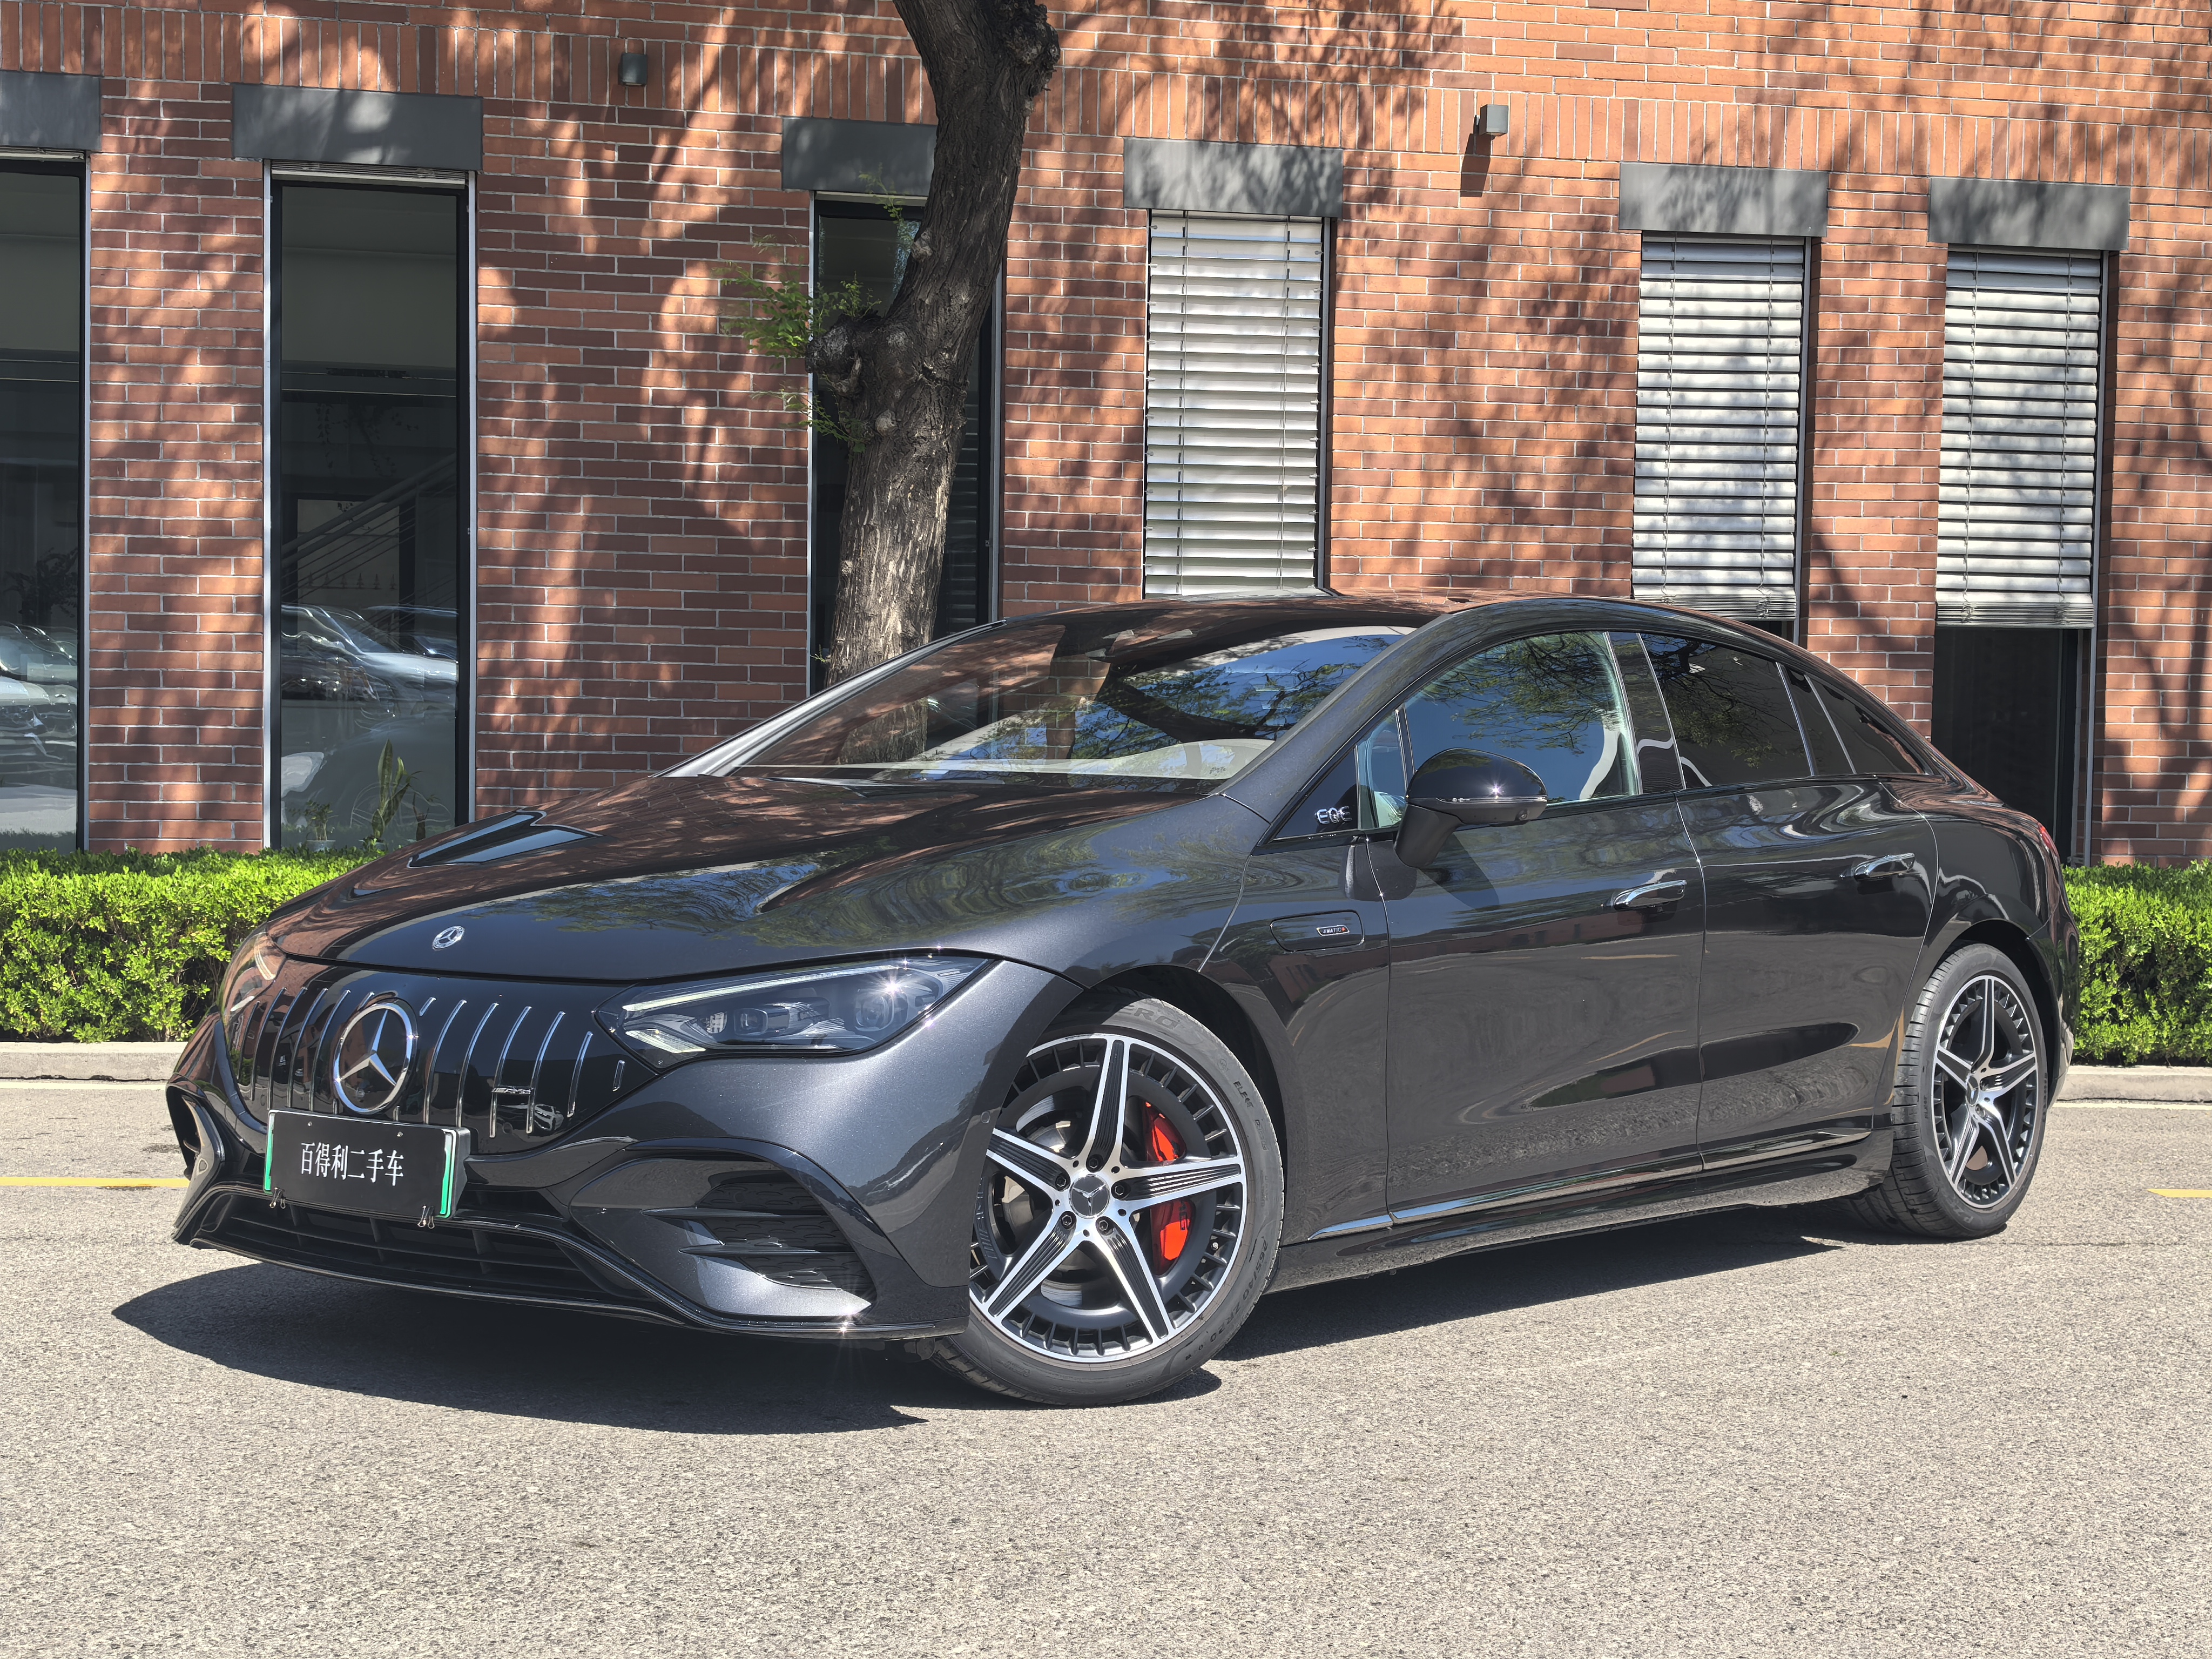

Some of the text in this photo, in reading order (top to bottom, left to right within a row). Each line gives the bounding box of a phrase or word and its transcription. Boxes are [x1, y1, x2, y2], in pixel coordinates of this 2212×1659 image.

[1314, 806, 1353, 825] EQE
[300, 1142, 404, 1186] 百得利二手车
